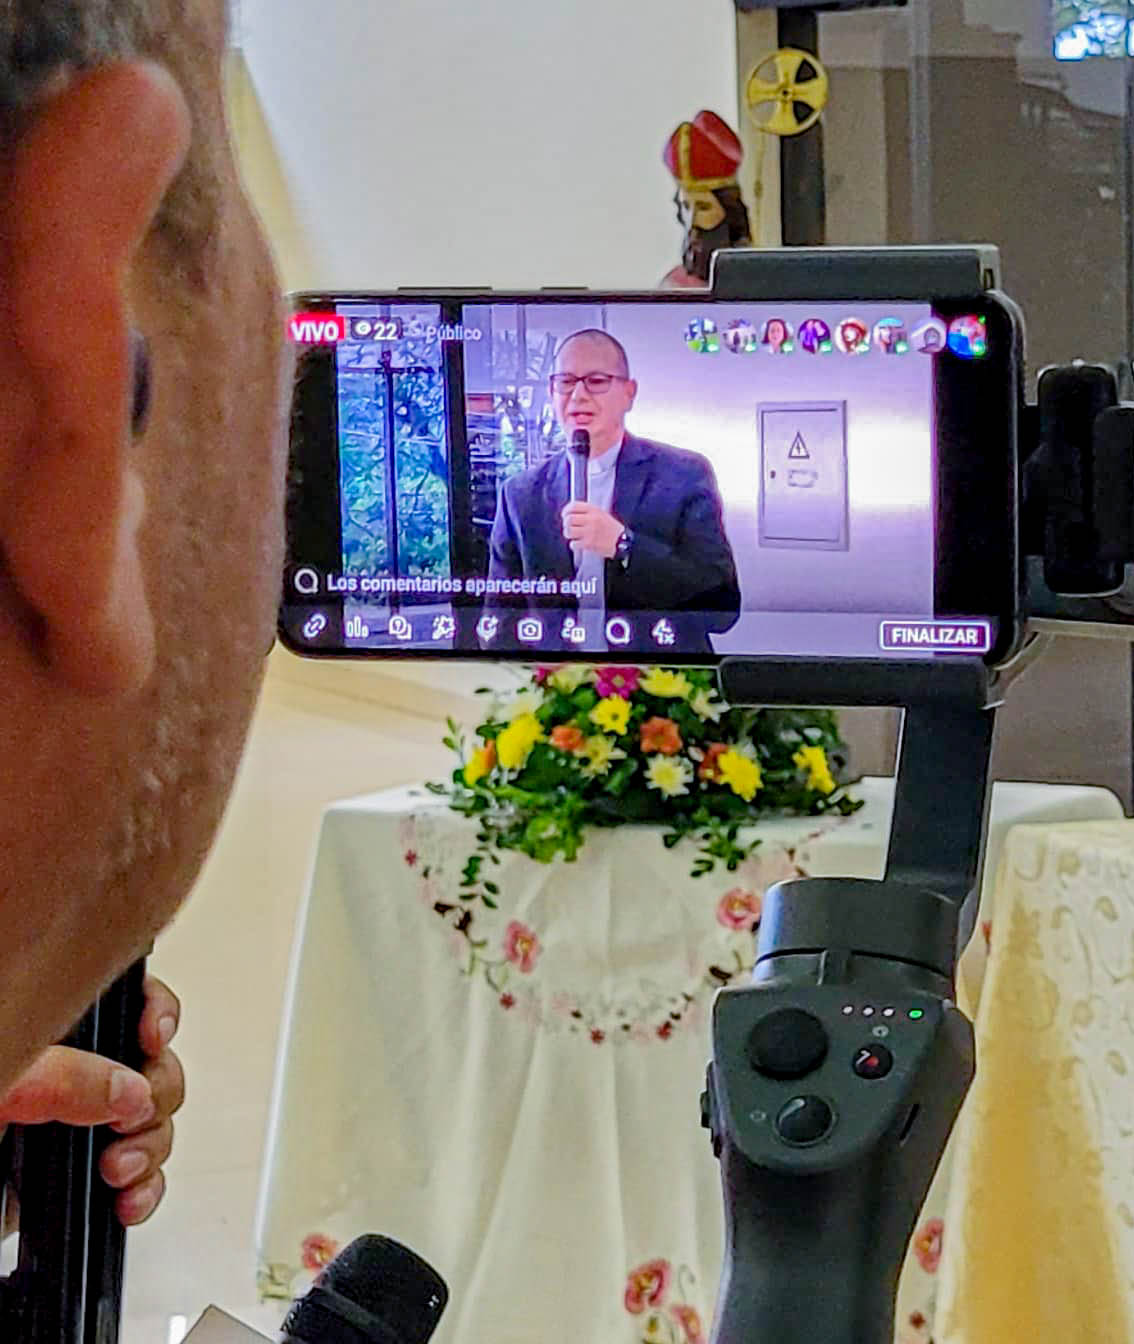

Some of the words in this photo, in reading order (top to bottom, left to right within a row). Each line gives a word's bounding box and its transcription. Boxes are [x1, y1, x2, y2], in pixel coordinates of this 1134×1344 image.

[290, 322, 339, 341] VIVO
[373, 323, 398, 341] 22
[426, 323, 482, 344] Público
[327, 574, 358, 591] Los
[361, 575, 463, 593] comentarios
[465, 575, 557, 597] aparecerán
[560, 576, 597, 598] aquí
[891, 627, 978, 645] FINALIZAR
